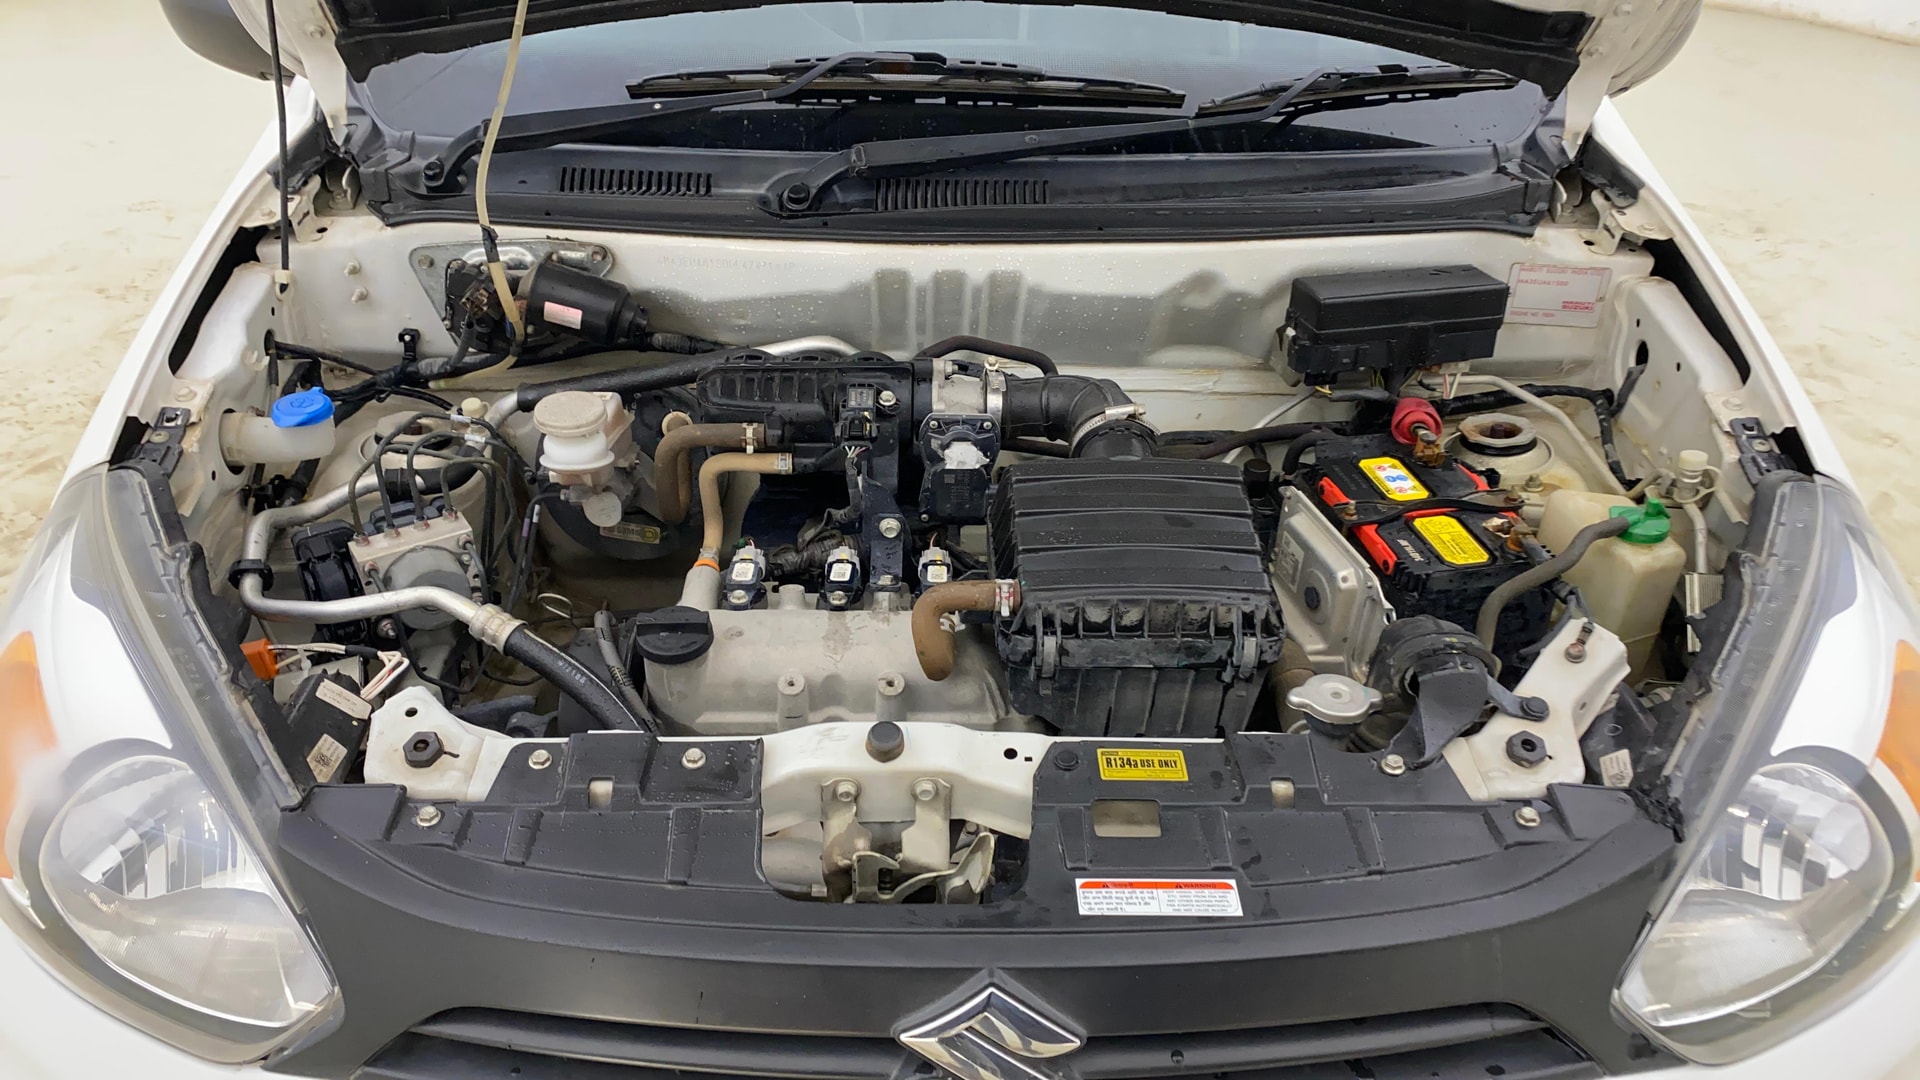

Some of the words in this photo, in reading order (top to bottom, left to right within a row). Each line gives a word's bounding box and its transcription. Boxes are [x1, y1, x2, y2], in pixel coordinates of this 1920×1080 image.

[1105, 757, 1138, 768] R134a
[1140, 759, 1155, 768] USE
[1158, 759, 1178, 768] ONLY
